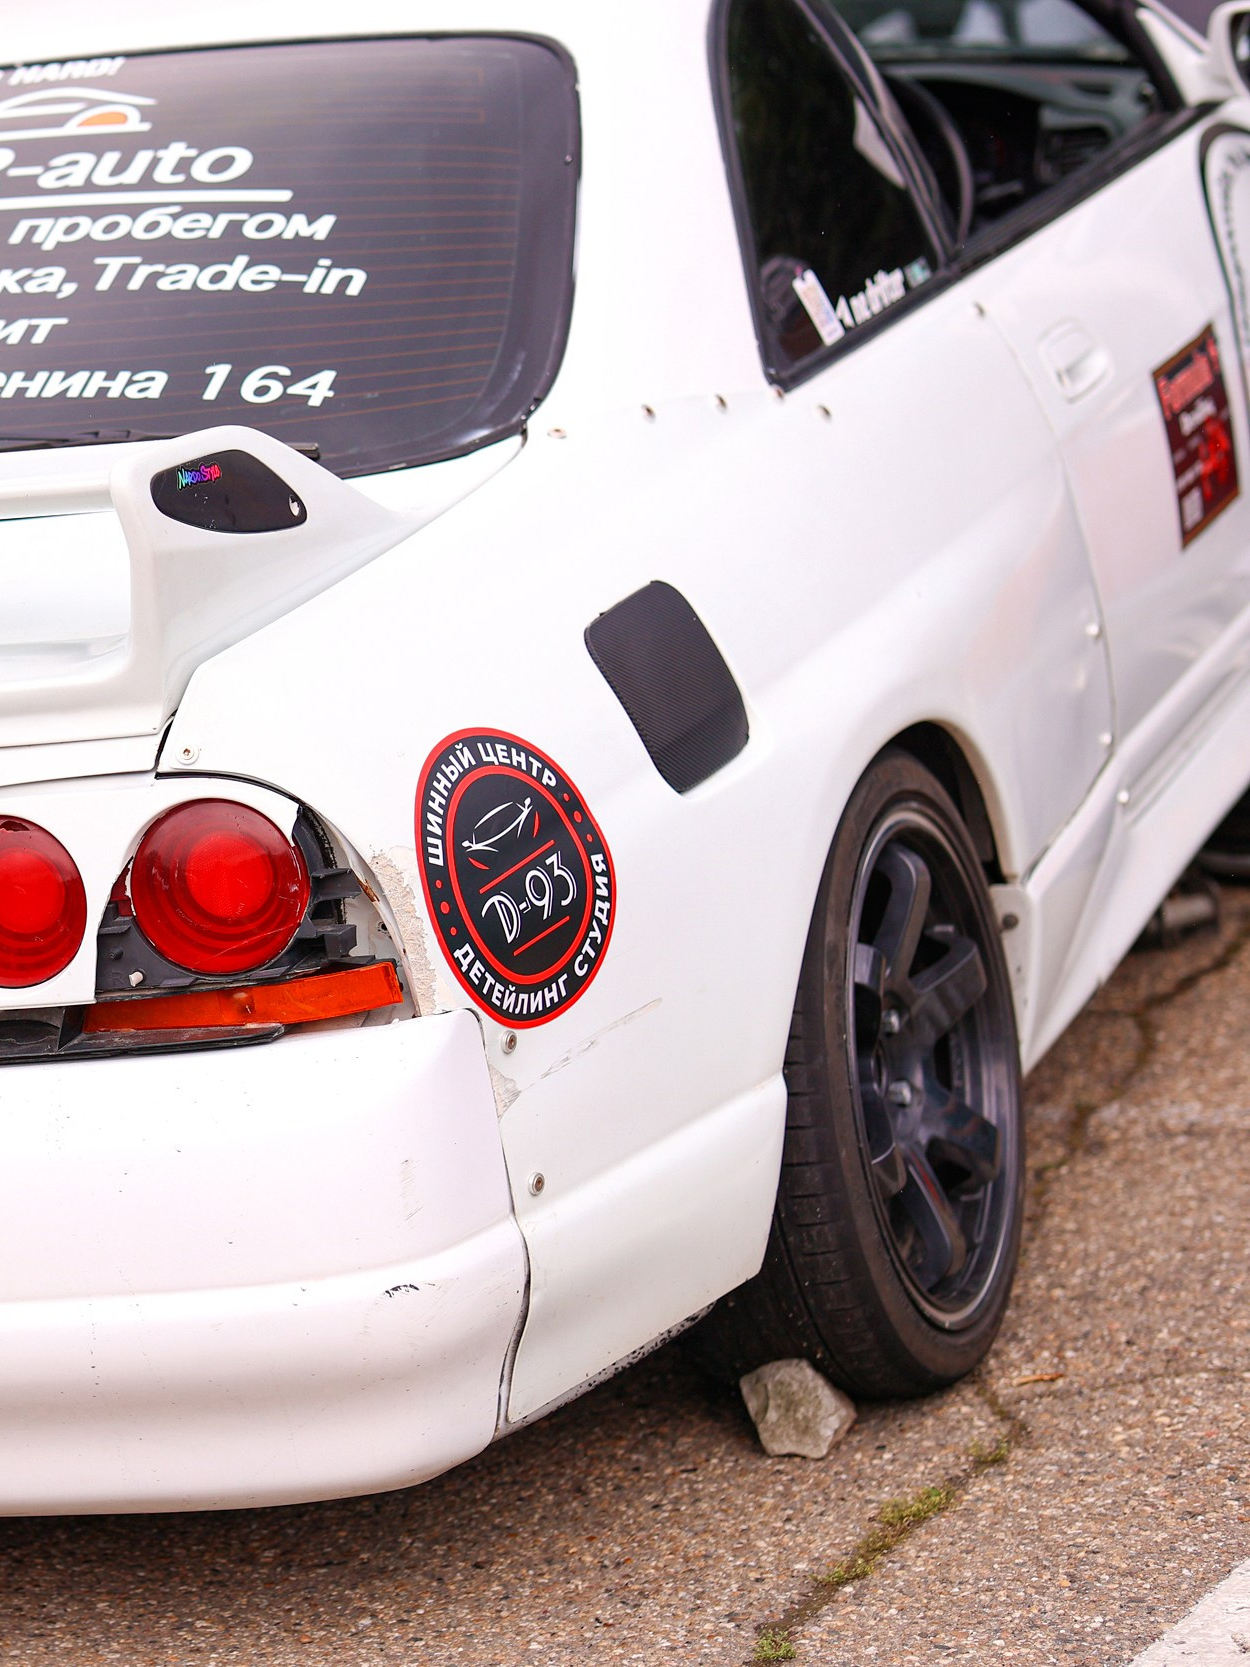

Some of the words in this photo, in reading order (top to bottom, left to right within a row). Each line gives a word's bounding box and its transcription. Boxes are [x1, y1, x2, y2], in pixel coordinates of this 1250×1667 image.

[6, 204, 337, 252] пробегом
[92, 254, 368, 297] Trade-in
[200, 363, 338, 408] 164
[426, 742, 477, 867] ШИННЫЙ
[476, 742, 558, 788] ЦЕНТР
[481, 850, 578, 944] D-93
[452, 942, 569, 1015] ДЕТЕЙЛИНГ
[573, 853, 612, 977] СТУДИЯ
